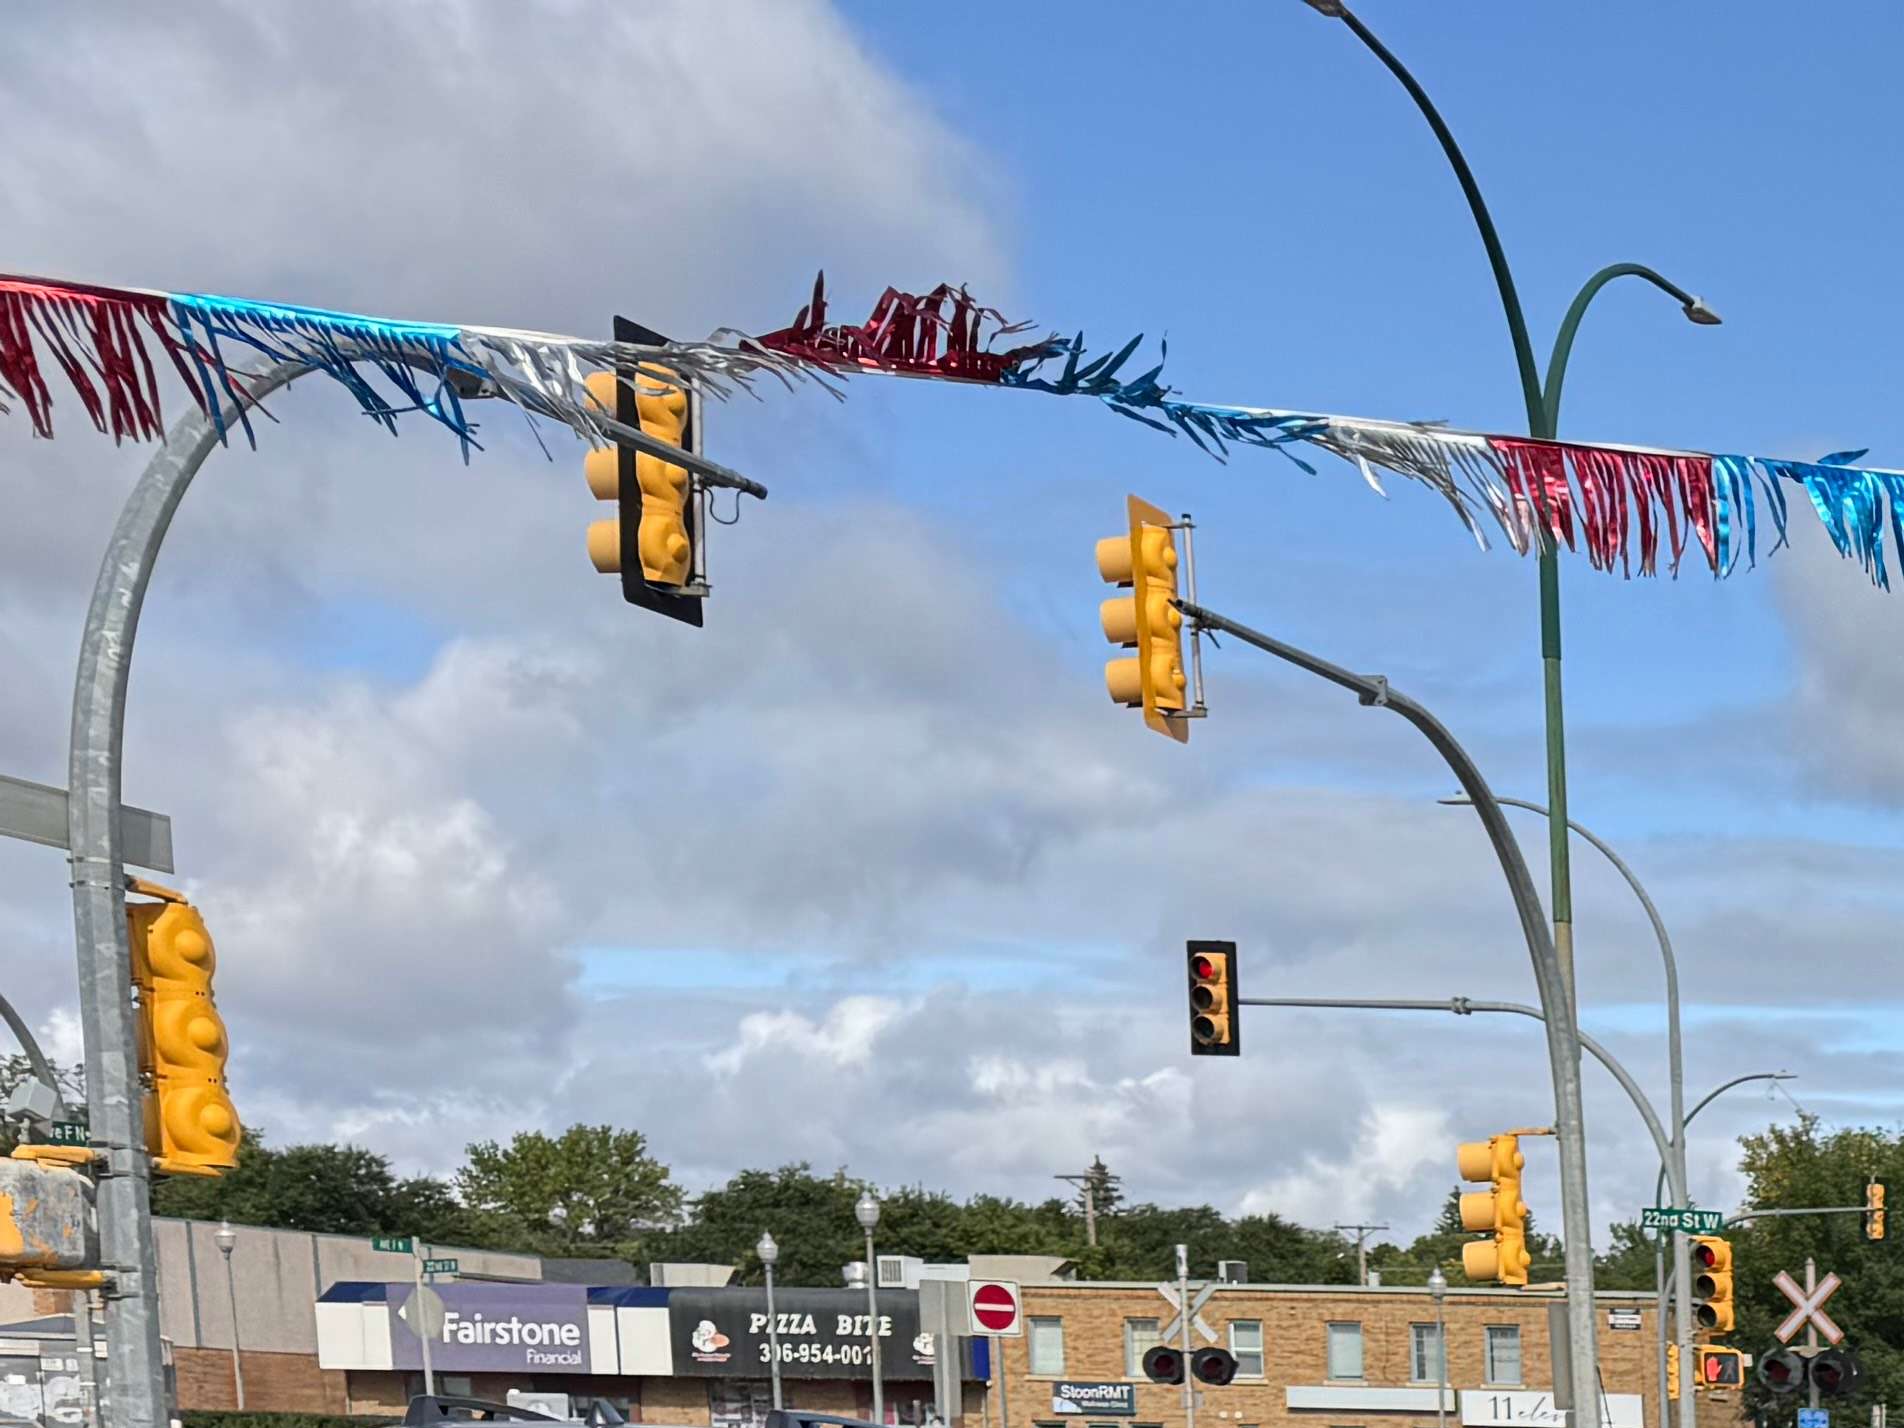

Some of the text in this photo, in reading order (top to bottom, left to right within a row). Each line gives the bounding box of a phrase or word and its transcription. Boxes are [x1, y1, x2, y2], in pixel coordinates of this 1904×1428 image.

[65, 1125, 73, 1140] F
[1644, 1211, 1719, 1229] 22nd St W
[443, 1311, 581, 1346] Fairstone
[836, 1314, 893, 1337] BITE
[526, 1349, 582, 1365] Financial
[1061, 1384, 1131, 1400] StoonRMT
[1488, 1395, 1511, 1420] 11
